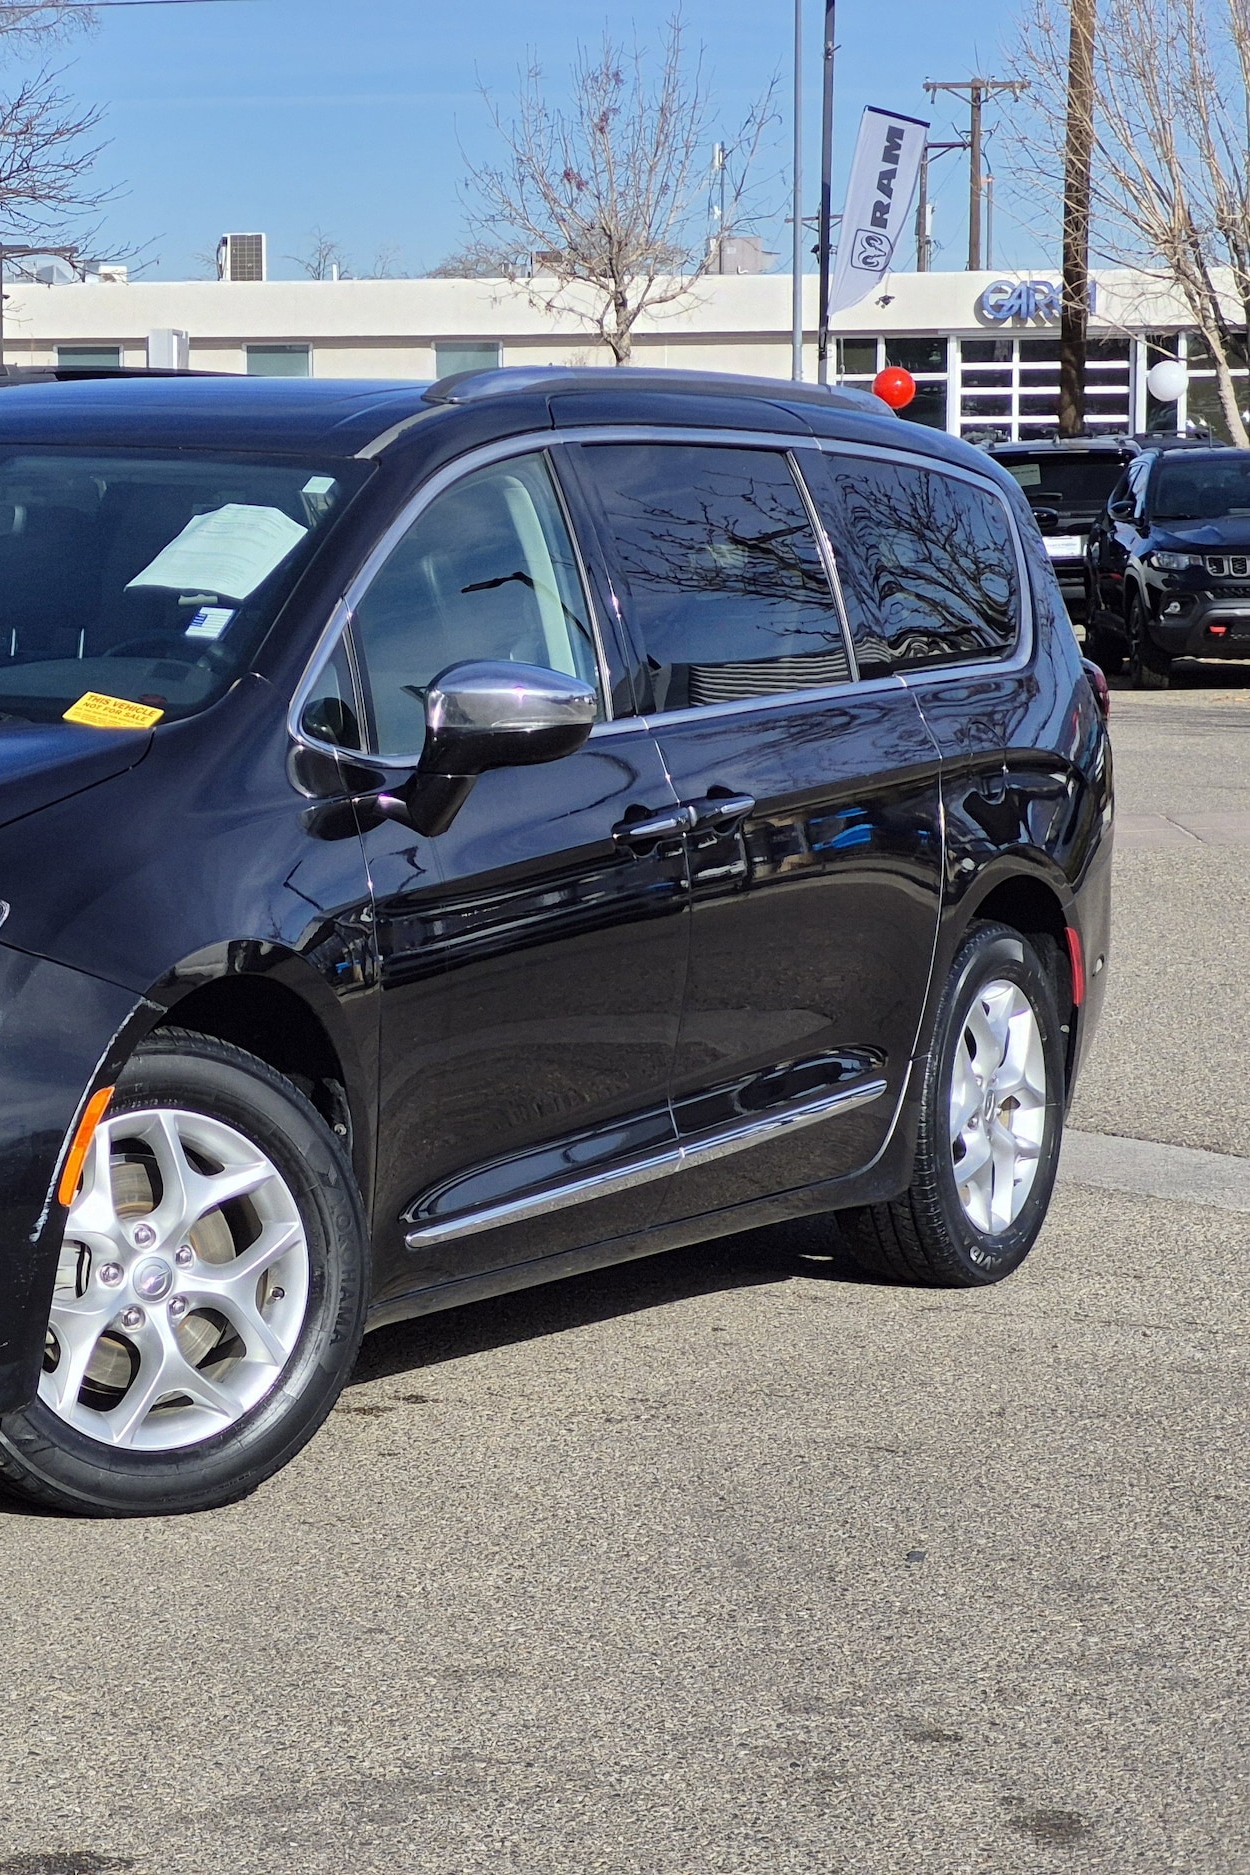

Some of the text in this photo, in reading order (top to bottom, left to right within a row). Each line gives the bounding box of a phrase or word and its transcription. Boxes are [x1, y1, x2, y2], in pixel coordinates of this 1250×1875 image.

[870, 125, 905, 229] RAM
[982, 279, 1097, 319] GAR
[83, 702, 102, 710] NOT
[103, 707, 123, 715] FOR
[123, 712, 148, 722] SALE
[86, 695, 111, 705] THIS
[112, 701, 158, 717] VEHICLE
